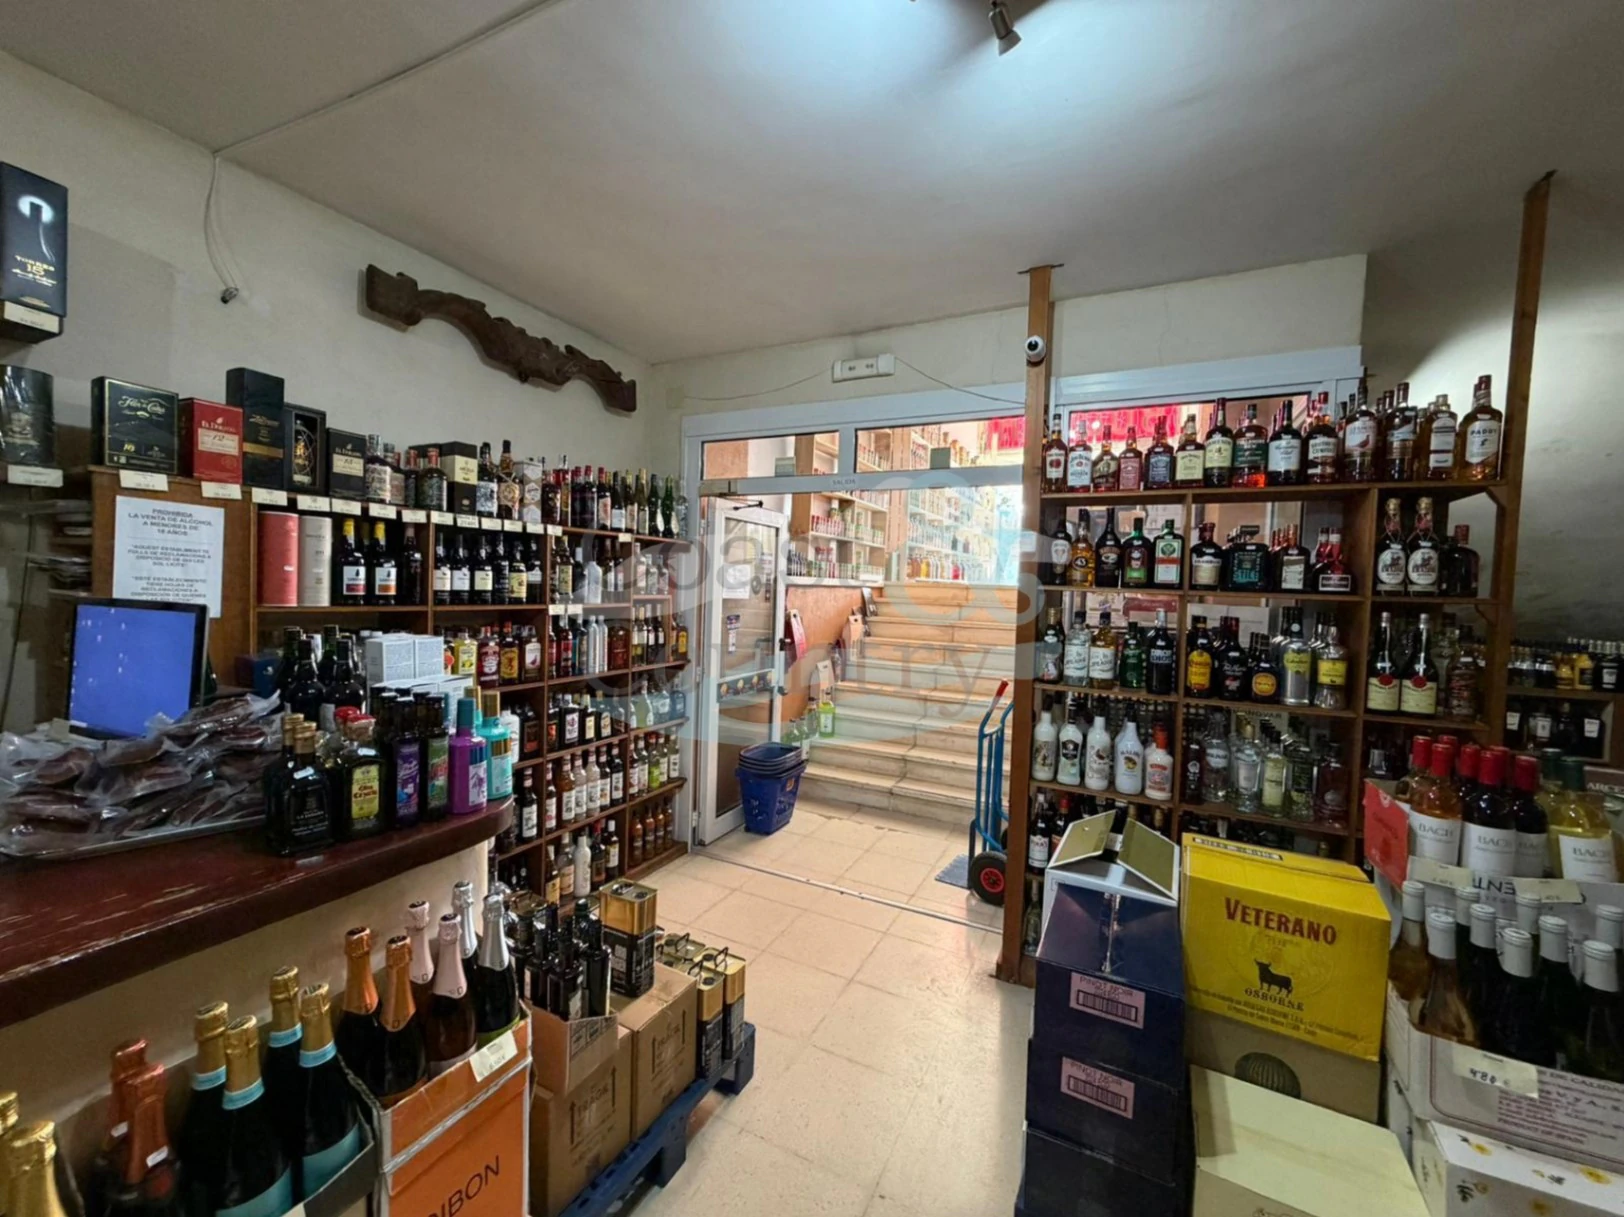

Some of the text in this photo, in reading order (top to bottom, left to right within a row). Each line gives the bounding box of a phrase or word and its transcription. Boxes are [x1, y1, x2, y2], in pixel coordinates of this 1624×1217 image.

[1470, 428, 1498, 436] PADDY
[140, 513, 167, 522] VENTA
[179, 517, 213, 527] ALCOHOL
[150, 521, 188, 530] MENORES
[1224, 897, 1338, 946] VETERANO
[1244, 987, 1305, 1012] OSBORNE
[428, 1154, 500, 1217] IBON
